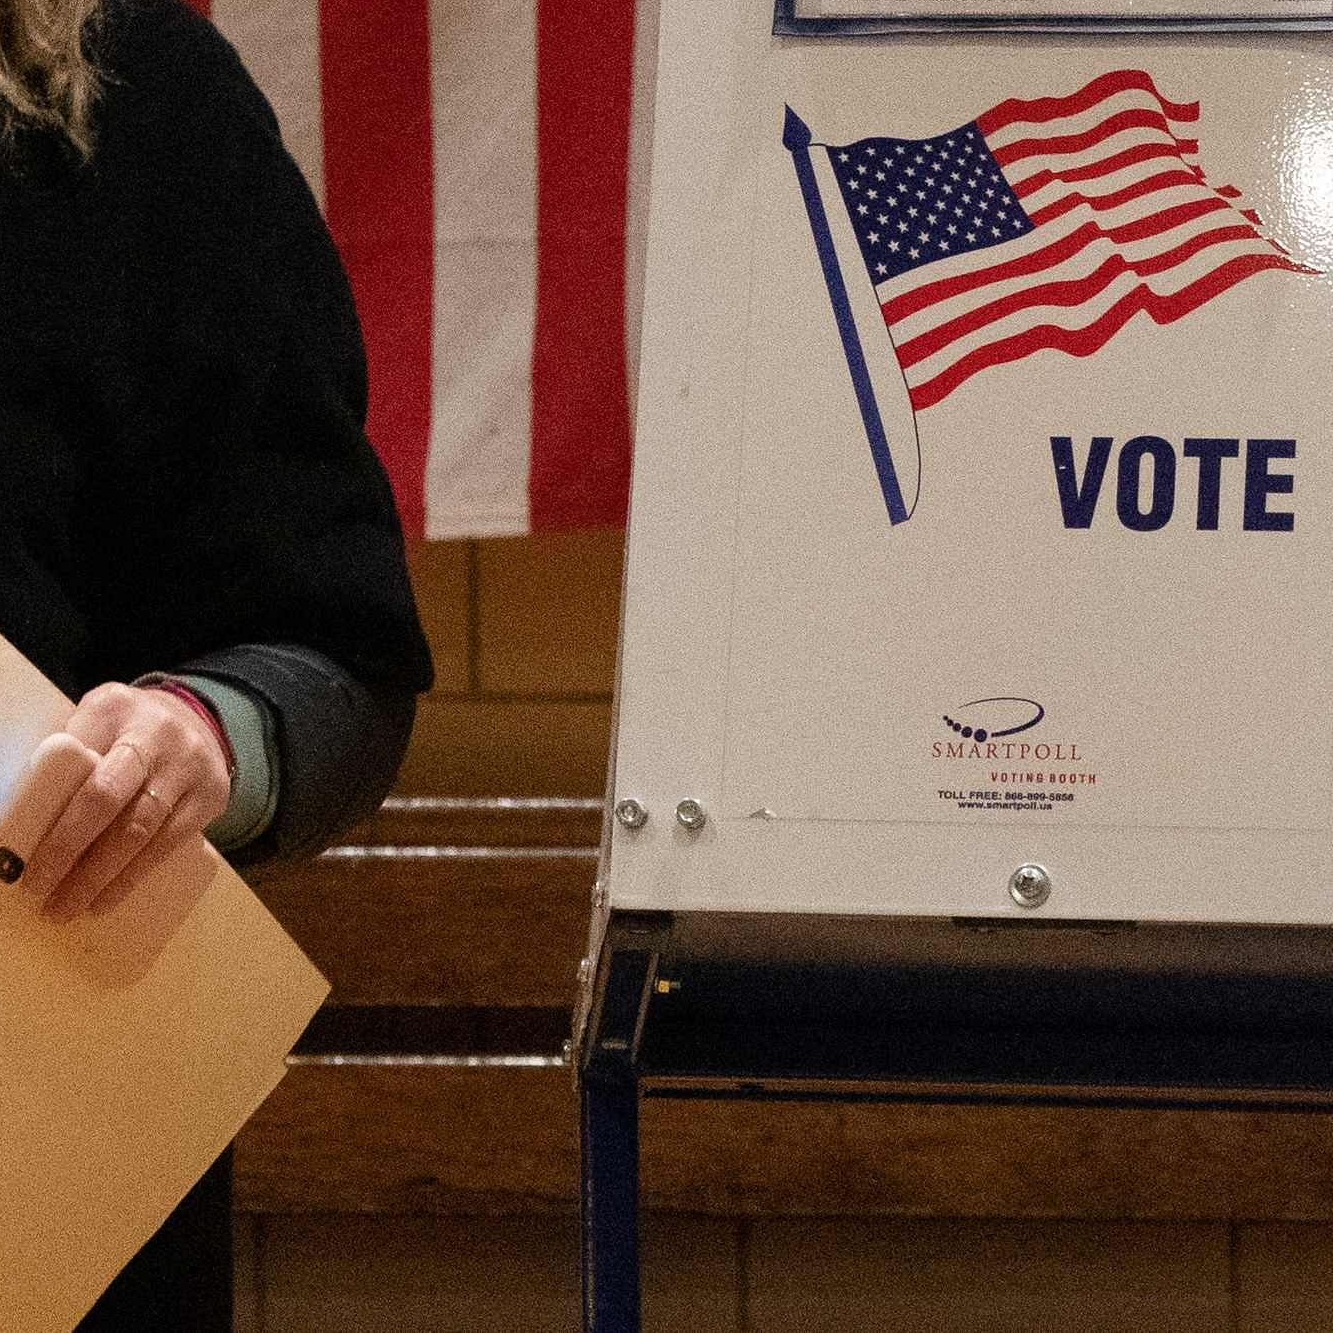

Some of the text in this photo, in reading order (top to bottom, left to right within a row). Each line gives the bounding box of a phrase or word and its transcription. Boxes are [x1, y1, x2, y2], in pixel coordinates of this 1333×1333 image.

[1049, 434, 1297, 533] VOTE
[932, 741, 1082, 761] SMARTPOLL
[991, 772, 1097, 785] VOTING BOOTH
[938, 790, 966, 800] TOLL
[969, 791, 1002, 801] FREE:
[958, 801, 1052, 811] www.smartpoll.us
